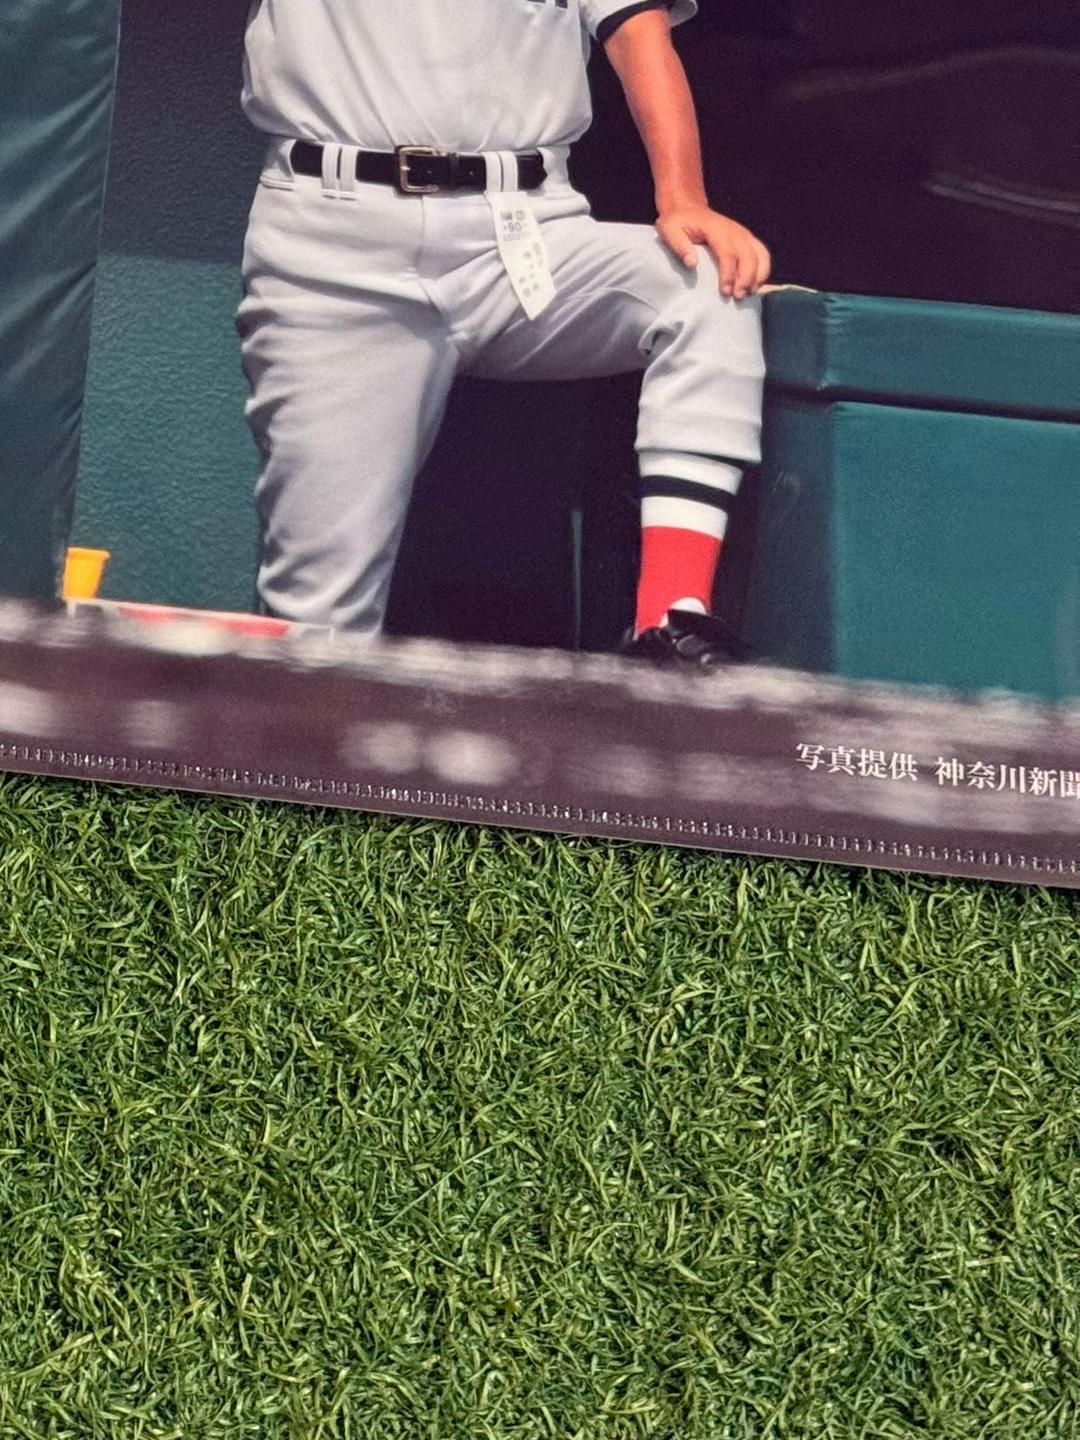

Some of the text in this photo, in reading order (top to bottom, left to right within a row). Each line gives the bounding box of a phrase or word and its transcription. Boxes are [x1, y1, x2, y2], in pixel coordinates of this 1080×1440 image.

[795, 742, 1080, 800] 写真提供 神奈川新聞
